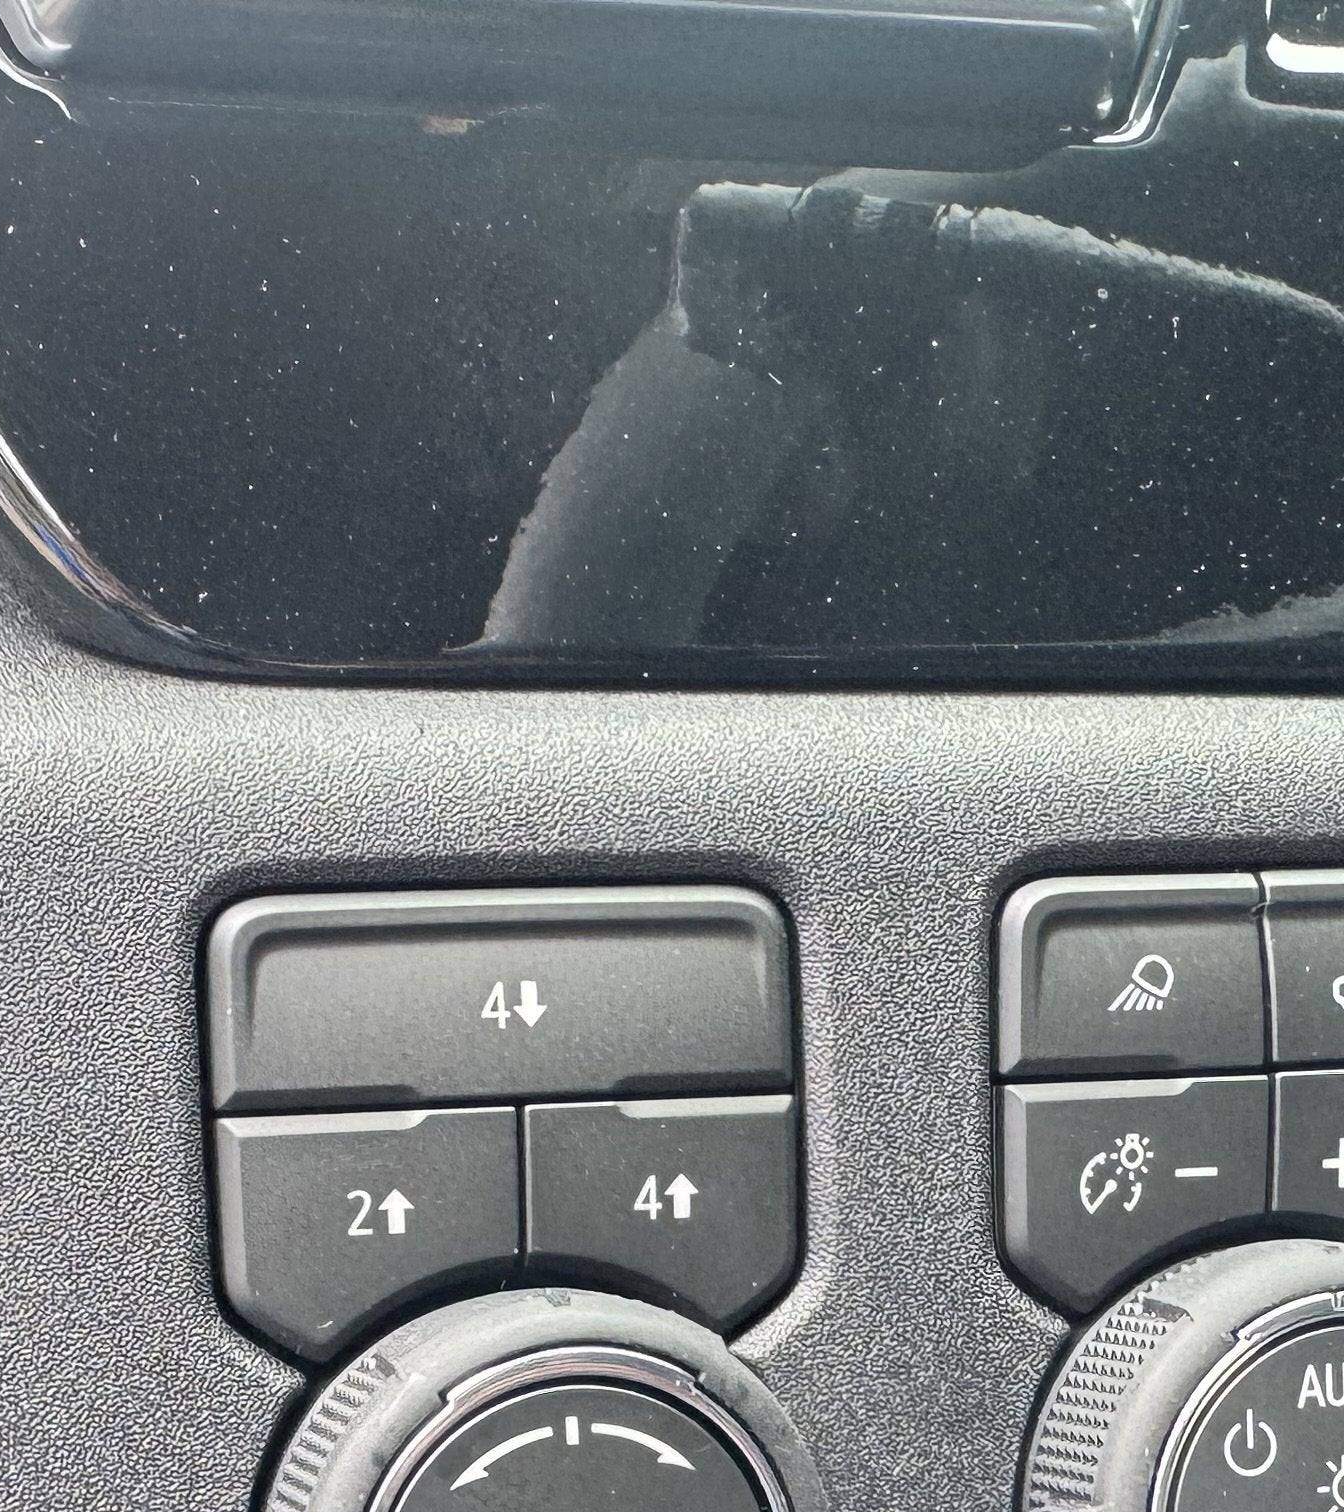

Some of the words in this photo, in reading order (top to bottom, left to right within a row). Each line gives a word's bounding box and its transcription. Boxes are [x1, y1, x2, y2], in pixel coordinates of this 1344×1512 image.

[480, 980, 511, 1030] 4
[346, 1189, 374, 1237] 2
[633, 1174, 663, 1221] 4
